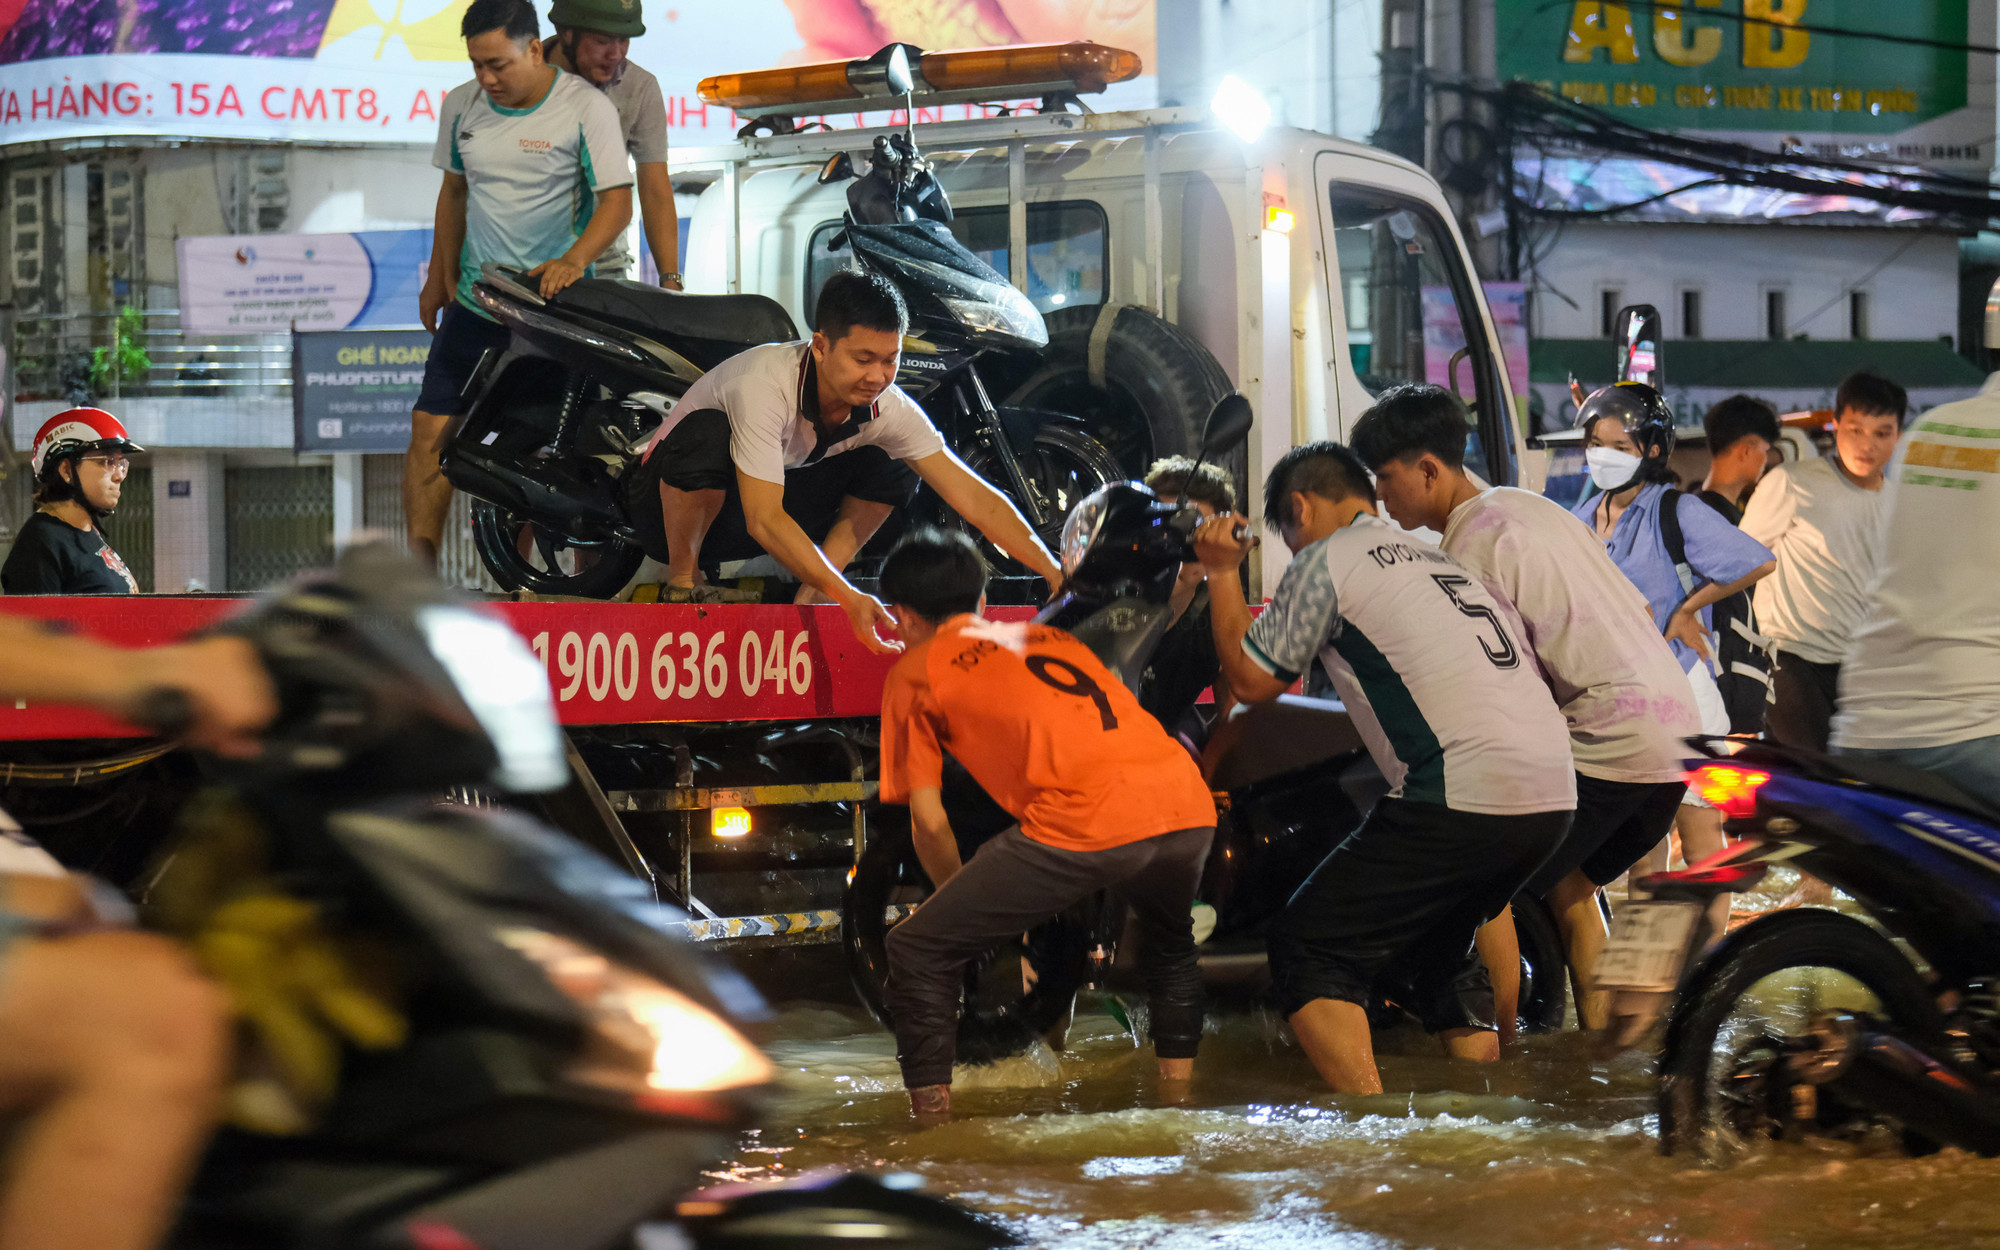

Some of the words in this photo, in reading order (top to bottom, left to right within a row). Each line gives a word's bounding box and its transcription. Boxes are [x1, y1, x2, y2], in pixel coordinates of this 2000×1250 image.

[1563, 0, 1811, 68] ACB
[32, 76, 153, 121] HÀNG:
[170, 82, 244, 117] 15A
[260, 86, 390, 126] CMT8,
[519, 139, 551, 149] TOYOTA
[54, 424, 75, 438] ABIC
[1430, 573, 1520, 670] 5
[532, 631, 639, 702] 1900
[651, 630, 728, 700] 636
[739, 630, 812, 697] 046
[1025, 655, 1118, 731] 9
